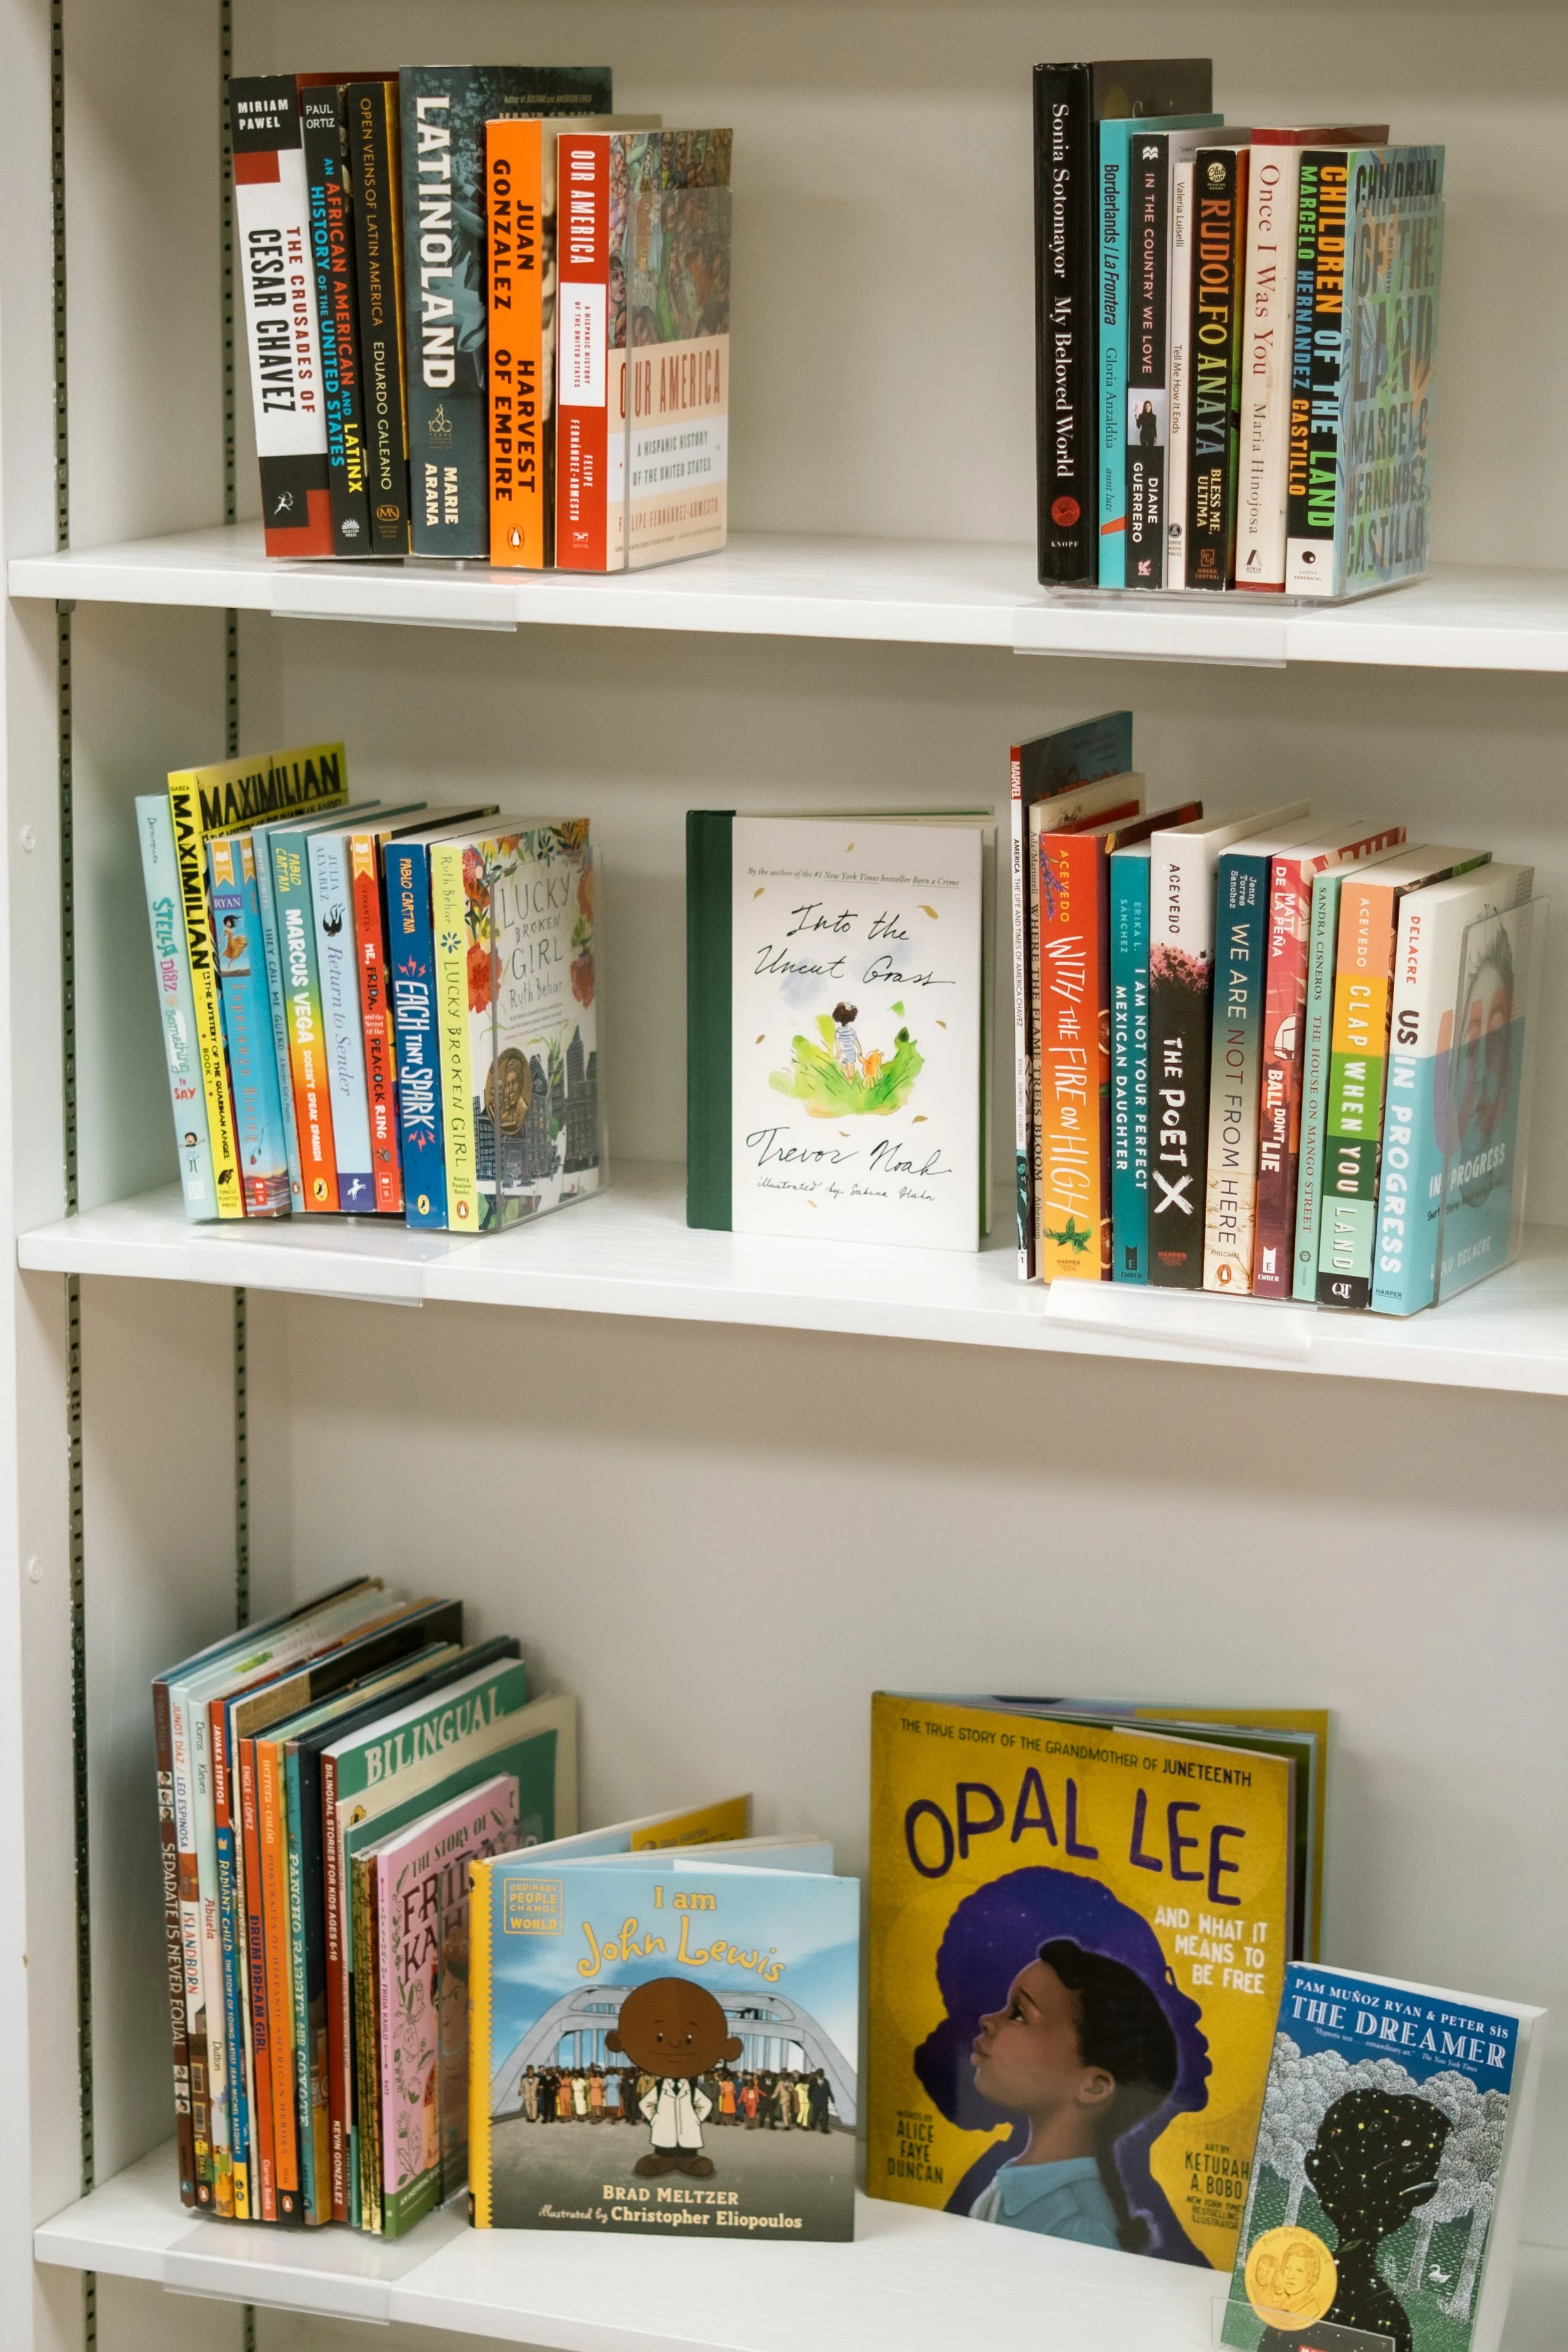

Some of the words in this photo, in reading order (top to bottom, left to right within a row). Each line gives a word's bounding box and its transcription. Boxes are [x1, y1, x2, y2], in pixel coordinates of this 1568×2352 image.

[238, 99, 289, 114] MIRIAM
[239, 116, 280, 130] PAWEL
[306, 105, 333, 115] PAUL
[306, 119, 335, 129] ORTIZ
[1052, 104, 1069, 161] Sonia
[325, 158, 334, 175] AN
[570, 151, 595, 181] OUR
[1144, 173, 1154, 188] IN
[570, 190, 595, 263] AMERICA
[1049, 169, 1069, 278] Sotomayor
[1145, 194, 1154, 222] THE
[1259, 165, 1279, 232] Once
[287, 226, 303, 264] THE
[311, 186, 330, 270] HISTORY
[326, 183, 346, 273] AFRICAN
[416, 96, 456, 389] LATINOLAND
[494, 159, 511, 309] GONZALEZ
[517, 201, 534, 270] JUAN
[1257, 243, 1277, 252] I
[1316, 167, 1348, 313] CHILDREN
[248, 229, 287, 307] CESAR
[318, 275, 326, 292] OF
[1143, 229, 1154, 300] COUNTRY
[1198, 198, 1231, 345] RUDOLFO
[1254, 265, 1276, 317] Was
[290, 275, 313, 380] CRUSADES
[319, 296, 329, 315] THE
[334, 281, 355, 386] AMERICAN
[1050, 296, 1072, 326] My
[1142, 307, 1153, 329] WE
[256, 320, 296, 413] CHAVEZ
[321, 320, 339, 393] UNITED
[495, 349, 511, 383] OF
[1055, 333, 1073, 415] Beloved
[1142, 336, 1152, 374] LOVE
[1253, 328, 1274, 376] You
[1314, 329, 1343, 364] OF
[300, 391, 315, 413] OF
[342, 391, 351, 416] AND
[373, 342, 388, 415] EDUARDO
[1196, 354, 1227, 457] ANAYA
[327, 401, 344, 467] STATES
[517, 360, 535, 492] HARVEST
[1311, 384, 1339, 434] THE
[344, 423, 363, 493] LATINX
[378, 421, 392, 490] GALEANO
[495, 396, 512, 501] EMPIRE
[1056, 416, 1074, 477] World
[1308, 451, 1337, 527] LAND
[199, 753, 341, 832] MAXIMILIAN
[172, 795, 209, 970] MAXIMILIAN
[215, 898, 241, 908] RYAN
[748, 867, 756, 876] By
[795, 870, 802, 879] of
[859, 873, 879, 881] Times
[881, 875, 911, 883] bestseller
[912, 877, 930, 885] Born
[1059, 850, 1069, 923] ACEVEDO
[285, 909, 309, 987] MARCUS
[787, 903, 857, 936] Into
[868, 911, 909, 940] the
[327, 945, 343, 1010] Return
[443, 961, 461, 1019] LUCKY
[754, 945, 847, 978] Uncut
[862, 956, 956, 986] Grass
[1045, 936, 1086, 1003] WITH
[1135, 982, 1147, 1006] AM
[293, 992, 314, 1044] VEGA
[334, 1012, 347, 1029] to
[395, 980, 430, 1031] EACH
[1057, 1005, 1081, 1040] THE
[1116, 986, 1127, 1066] MEXICAN
[1135, 1015, 1147, 1051] NOT
[1347, 985, 1370, 1047] CLAP
[1397, 1010, 1419, 1046] US
[335, 1034, 354, 1096] Sender
[405, 1034, 423, 1065] TINY
[448, 1028, 464, 1110] BROKEN
[1048, 1047, 1087, 1106] FIRE
[1163, 1037, 1182, 1078] THE
[1393, 1056, 1416, 1088] IN
[401, 1066, 435, 1129] SPARK
[1135, 1059, 1147, 1105] YOUR
[1340, 1062, 1366, 1131] WHEN
[451, 1118, 467, 1167] GIRL
[746, 1126, 859, 1167] Trevor
[1061, 1107, 1080, 1130] ON
[1116, 1076, 1128, 1170] DAUGHTER
[1159, 1089, 1187, 1167] POET
[1046, 1134, 1090, 1219] HIGH
[1135, 1114, 1147, 1189] PERFECT
[1337, 1147, 1360, 1193] YOU
[1152, 1169, 1194, 1215] X
[1380, 1105, 1412, 1273] PROGRESS
[1332, 1207, 1357, 1269] LAND
[364, 1687, 504, 1786] BILINGUAL
[901, 1717, 921, 1733] THE
[925, 1722, 954, 1737] TRUE
[958, 1728, 997, 1746] STORY
[1000, 1734, 1015, 1747] OF
[1020, 1736, 1041, 1751] THE
[1046, 1740, 1138, 1767] GRANDMOTHER
[1142, 1756, 1157, 1770] OF
[1162, 1759, 1251, 1788] JUNETEENTH
[904, 1767, 1099, 1878] OPAL
[1129, 1788, 1246, 1906] LEE
[162, 1843, 179, 1923] SEPARATE
[655, 1886, 664, 1909] I
[674, 1891, 716, 1910] am
[166, 1925, 179, 1939] IS
[577, 1917, 667, 1978] John
[677, 1915, 785, 1983] Lewis
[1155, 1905, 1189, 1929] AND
[1199, 1913, 1244, 1941] WHAT
[1253, 1923, 1268, 1943] IT
[1175, 1934, 1234, 1963] MEANS
[1244, 1946, 1264, 1968] TO
[167, 1945, 183, 1993] NEVER
[183, 1912, 199, 1994] ISLANDBORN
[1192, 1964, 1214, 1985] BE
[1222, 1968, 1264, 1994] FREE
[169, 1999, 186, 2047] EQUAL
[1291, 1995, 1347, 2030] THE
[1355, 2010, 1506, 2069] DREAMER
[1295, 1979, 1325, 1994] PAM
[1330, 1986, 1380, 2008] MUÑOZ
[1385, 2000, 1422, 2018] RYAN
[1426, 2010, 1435, 2021] &
[1440, 2013, 1485, 2033] PETER
[1490, 2024, 1509, 2038] SÍS
[1185, 2151, 1249, 2180] KETURAH
[1207, 2176, 1242, 2200] BOBO
[595, 2208, 608, 2223] by
[611, 2206, 709, 2227] Christopher
[716, 2212, 802, 2230] Eliopoulos
[603, 2185, 650, 2201] BRAD
[657, 2187, 738, 2205] MELTZER
